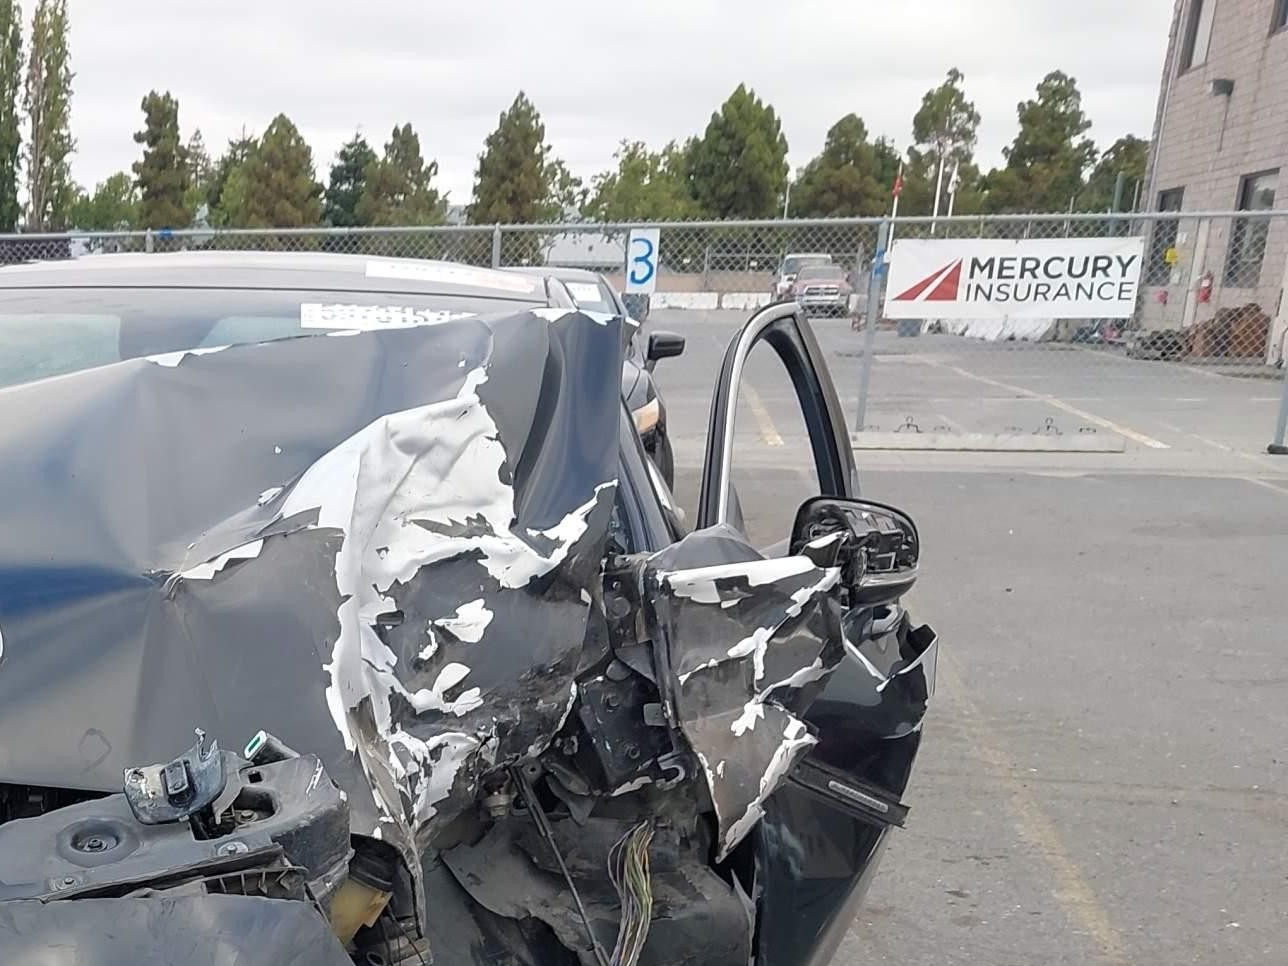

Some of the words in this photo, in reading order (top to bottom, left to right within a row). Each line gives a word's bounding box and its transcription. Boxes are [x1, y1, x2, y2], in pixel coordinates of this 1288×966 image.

[630, 238, 654, 284] 3
[968, 255, 1137, 280] MERCURY
[965, 281, 1135, 302] INSURANCE
